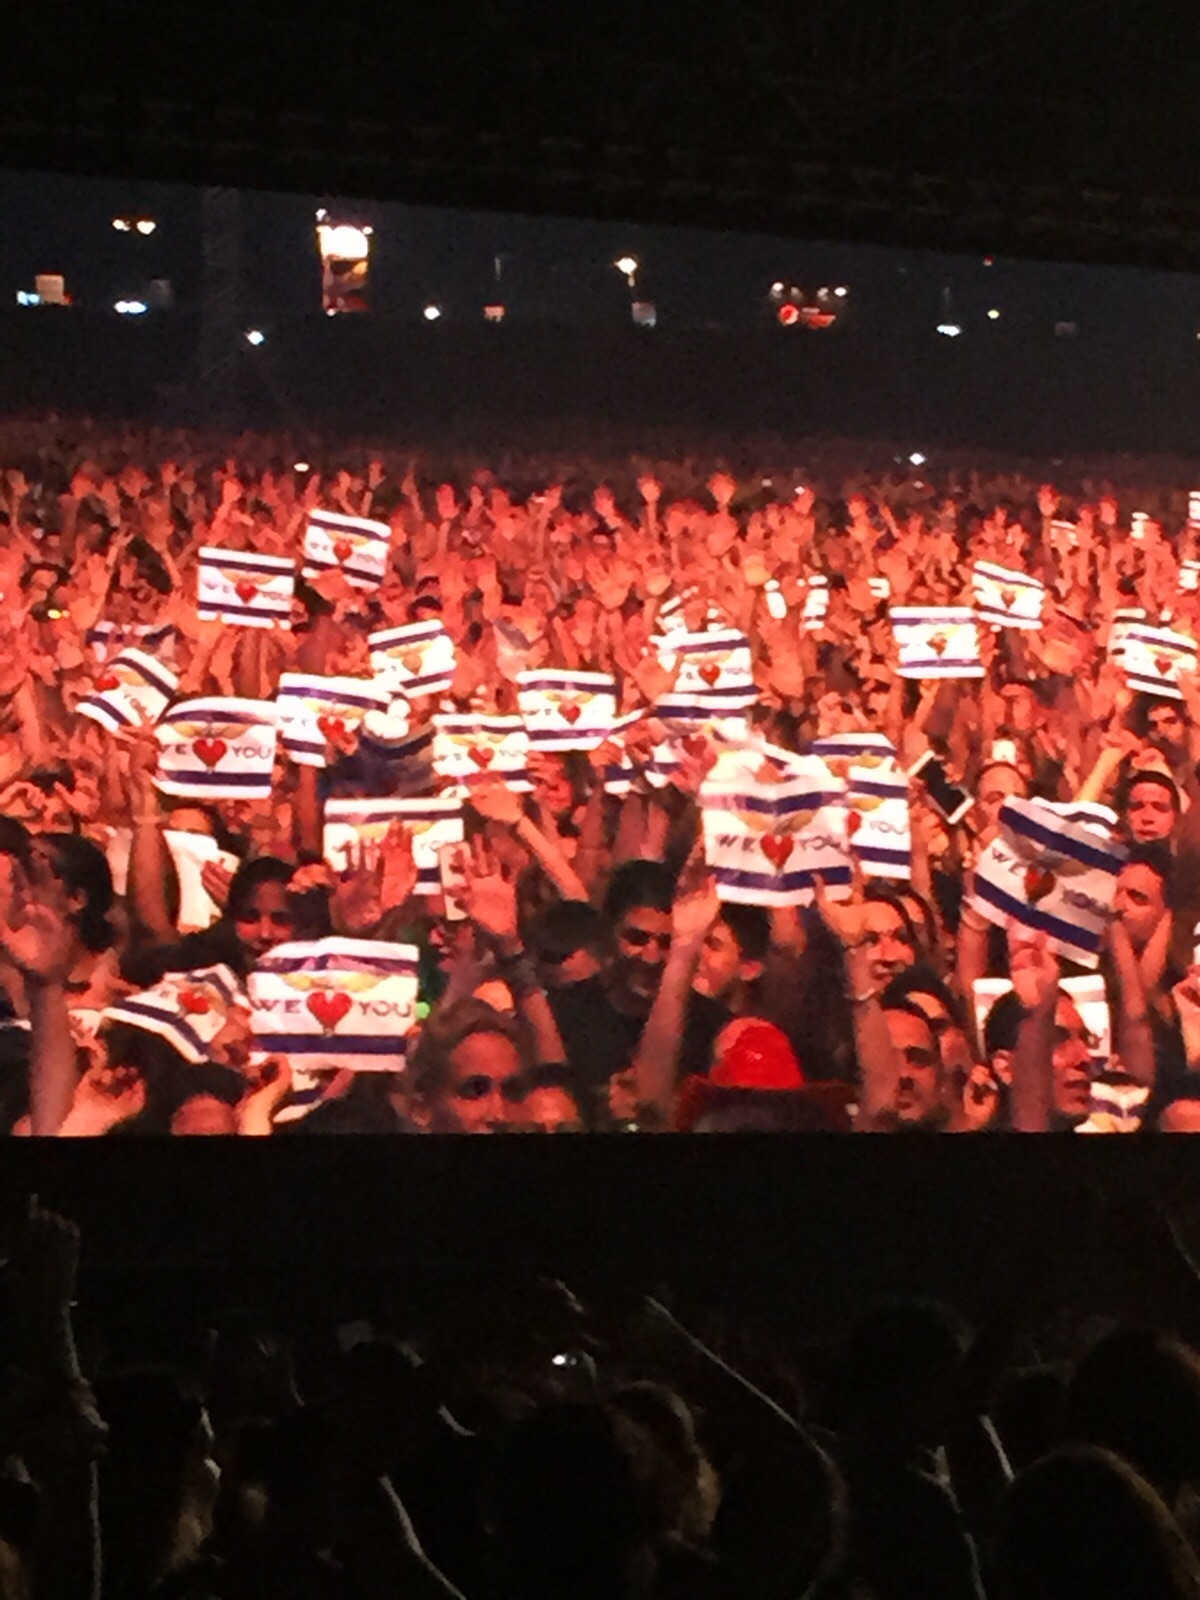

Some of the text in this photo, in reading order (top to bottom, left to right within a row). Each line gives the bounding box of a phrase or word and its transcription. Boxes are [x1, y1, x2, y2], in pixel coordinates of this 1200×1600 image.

[231, 746, 272, 760] YOU
[715, 834, 759, 853] WE
[991, 847, 1028, 877] WE
[249, 998, 413, 1019] WE YOU
